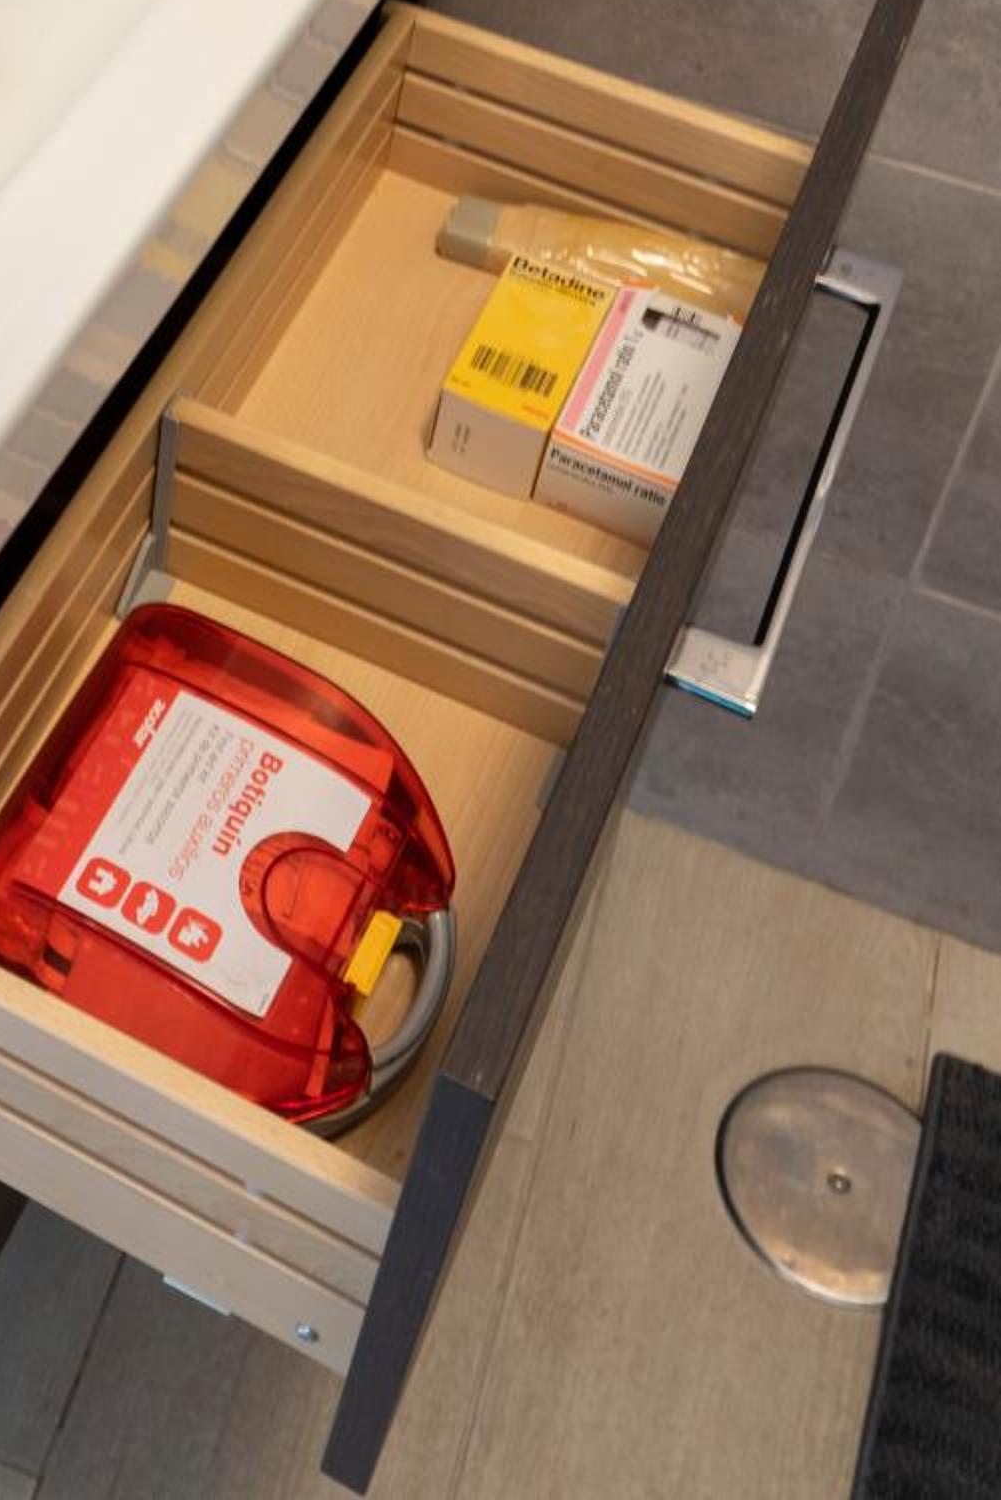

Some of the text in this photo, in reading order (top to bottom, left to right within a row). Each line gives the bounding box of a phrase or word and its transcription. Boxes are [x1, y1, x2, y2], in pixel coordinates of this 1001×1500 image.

[510, 256, 606, 299] Betadine
[550, 447, 634, 492] Paracetamol
[633, 482, 667, 507] ratio
[167, 737, 255, 881] primeros auxilios
[211, 751, 285, 857] Botiquín
